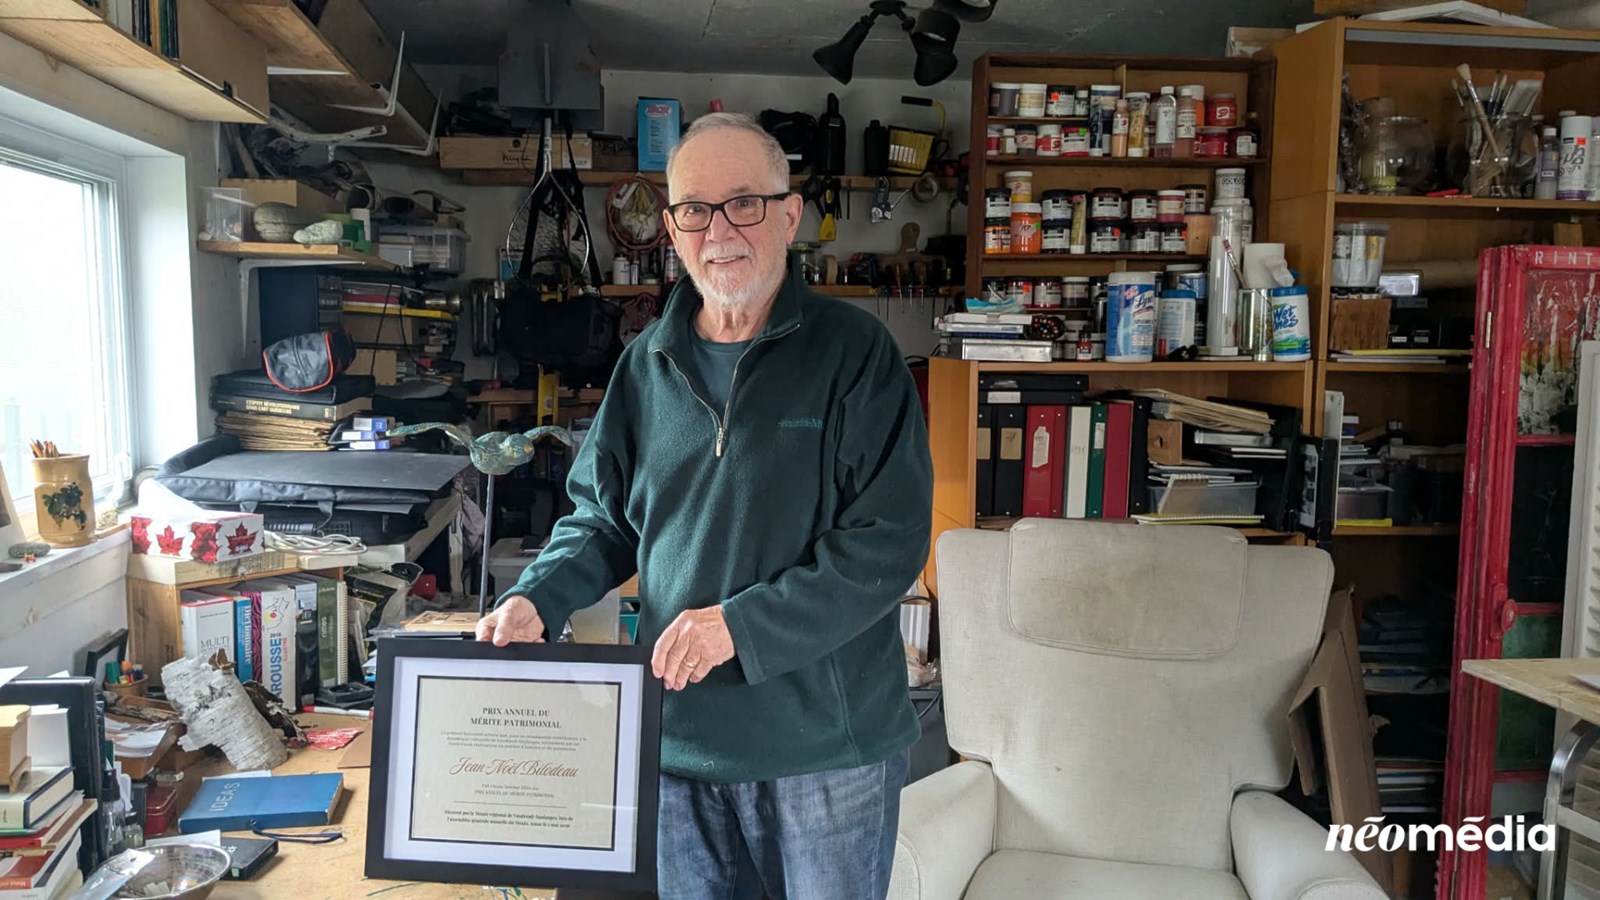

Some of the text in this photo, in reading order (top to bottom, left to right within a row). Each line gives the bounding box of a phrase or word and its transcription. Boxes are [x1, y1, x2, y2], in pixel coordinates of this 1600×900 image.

[1273, 304, 1297, 321] Wet
[200, 635, 230, 648] MULTI
[270, 638, 282, 697] ROUSSE
[482, 707, 551, 718] PRIX ANNUEL DU
[470, 717, 562, 729] MÉRITE PATRIMONIAL
[450, 757, 578, 777] Jean-Noël Bilodeau
[208, 782, 240, 812] IDEAS
